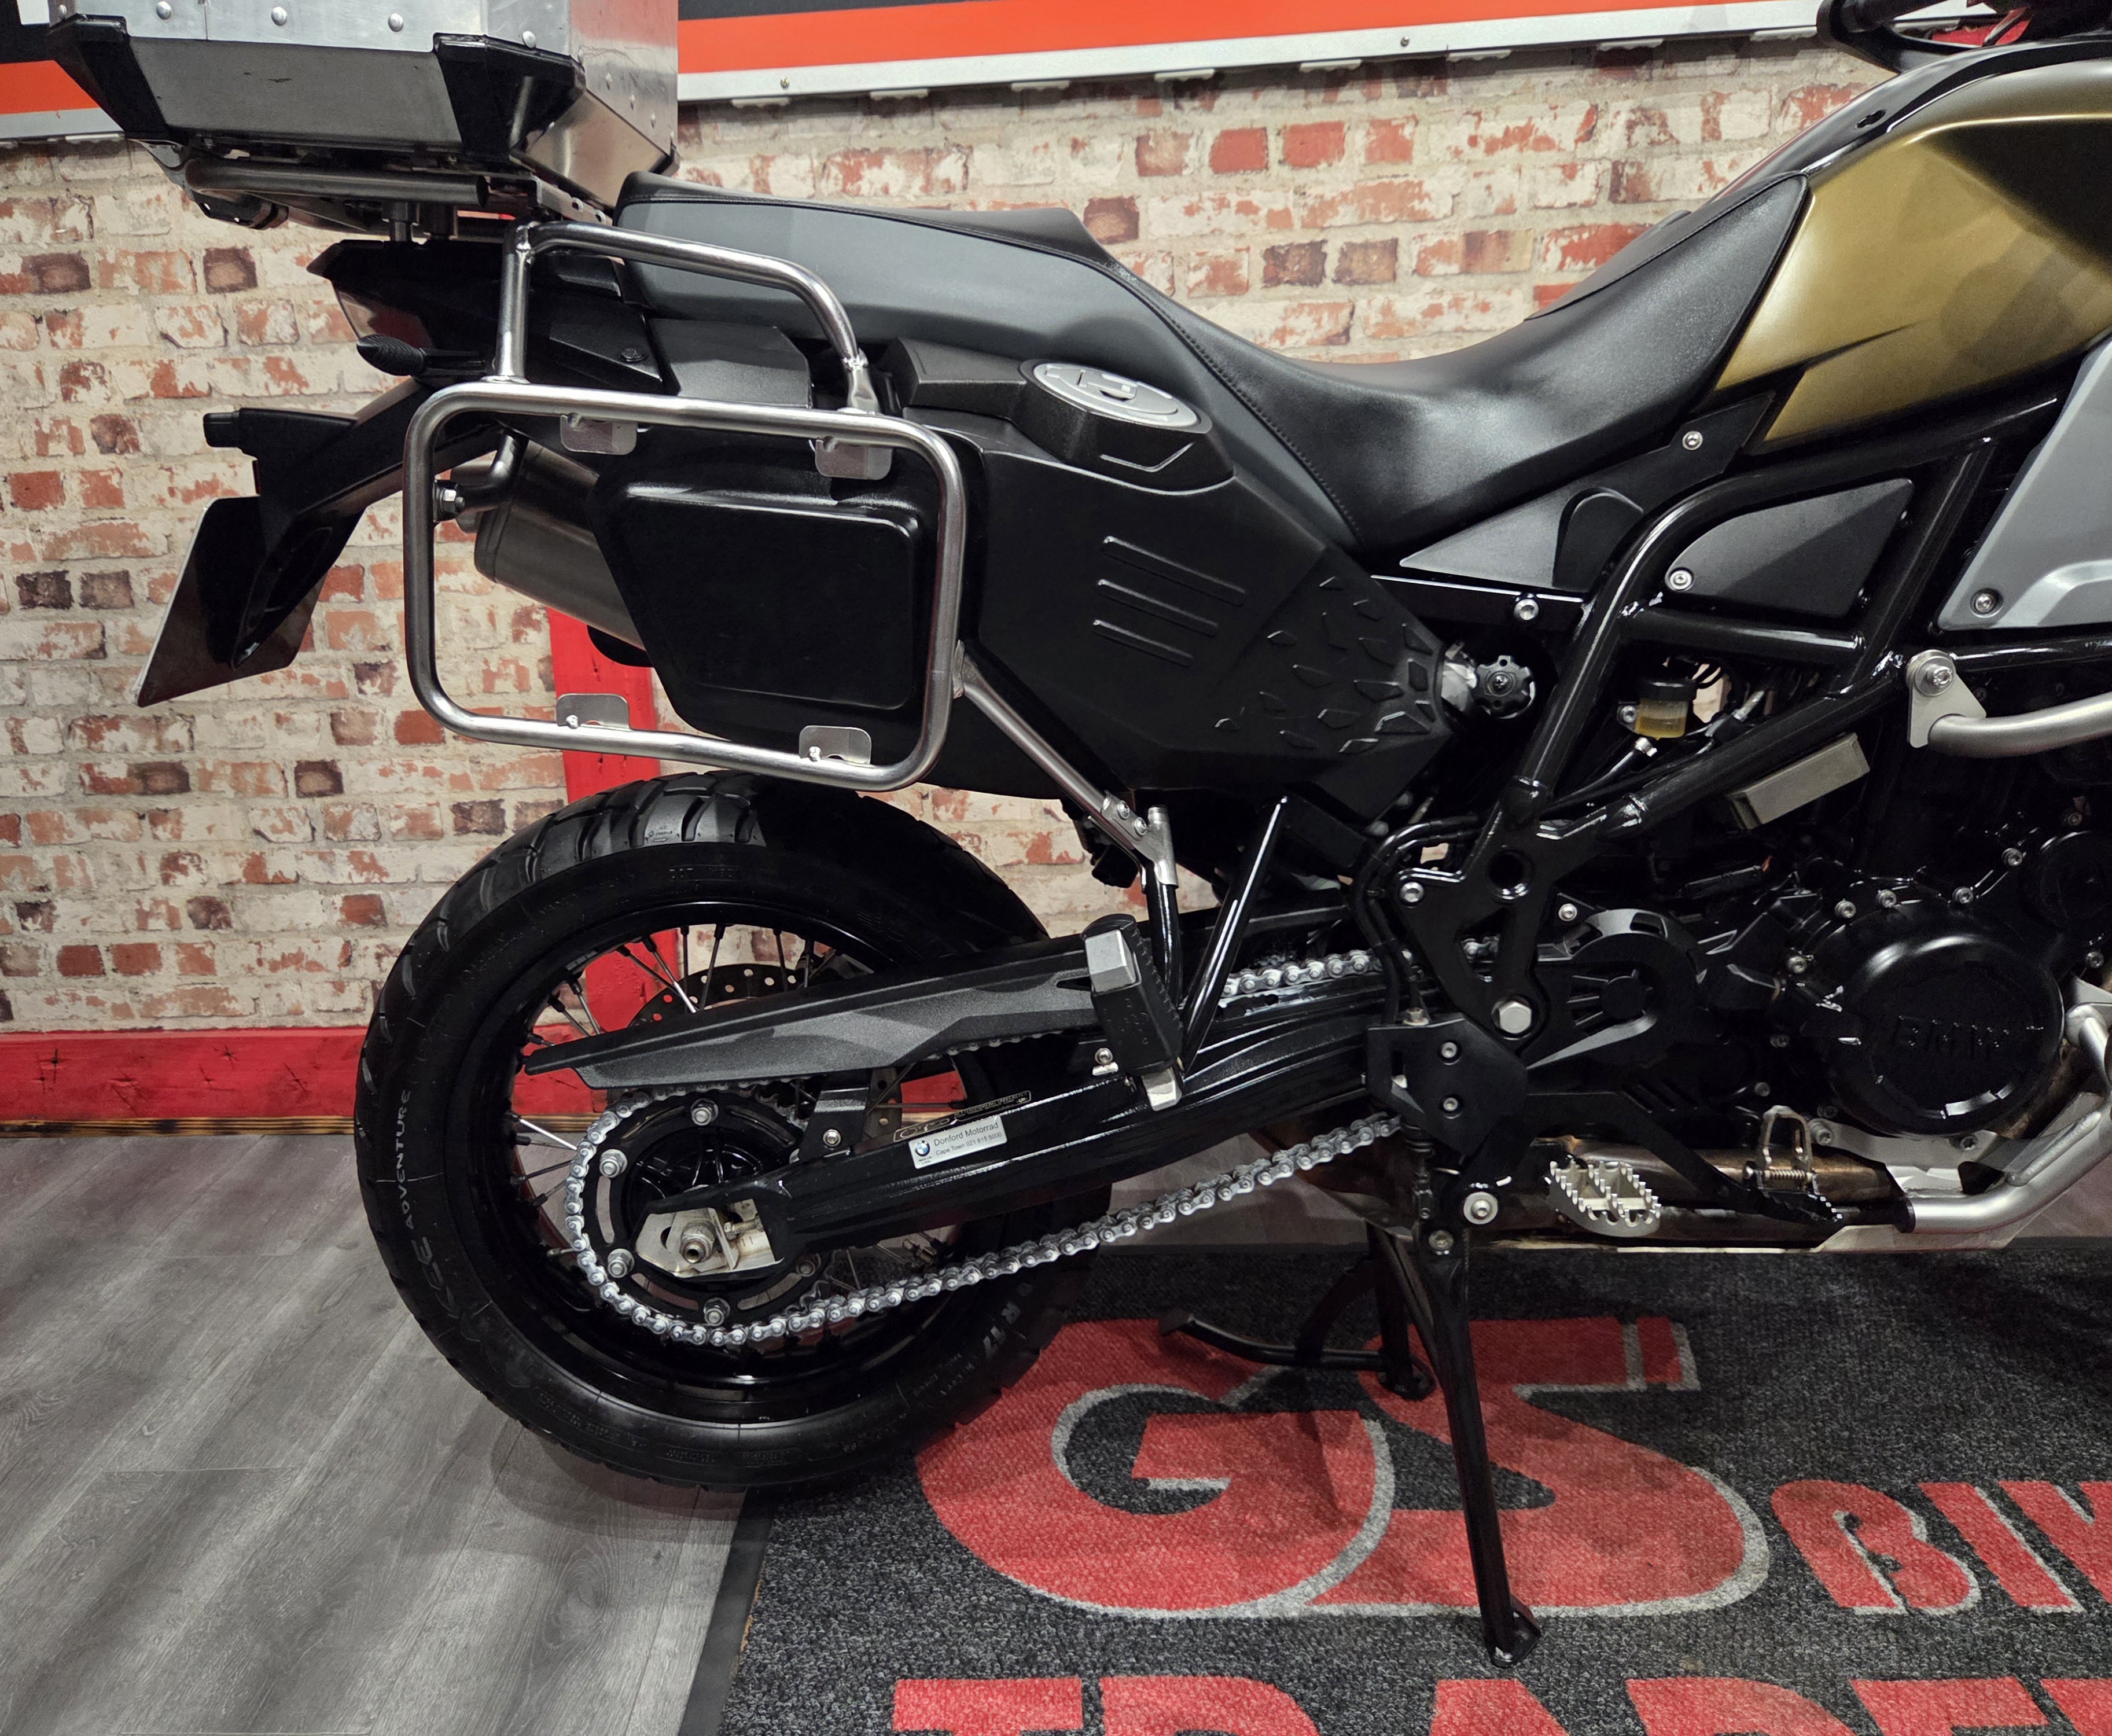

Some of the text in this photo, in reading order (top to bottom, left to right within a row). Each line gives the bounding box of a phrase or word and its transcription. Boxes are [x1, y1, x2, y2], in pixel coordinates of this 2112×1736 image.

[395, 1089, 415, 1230] ADVENTURE
[933, 1131, 964, 1147] Donford
[965, 1121, 999, 1138] Motorrad
[935, 1131, 1003, 1156] Cape Town 021 815 5000
[915, 1316, 1769, 1619] GS
